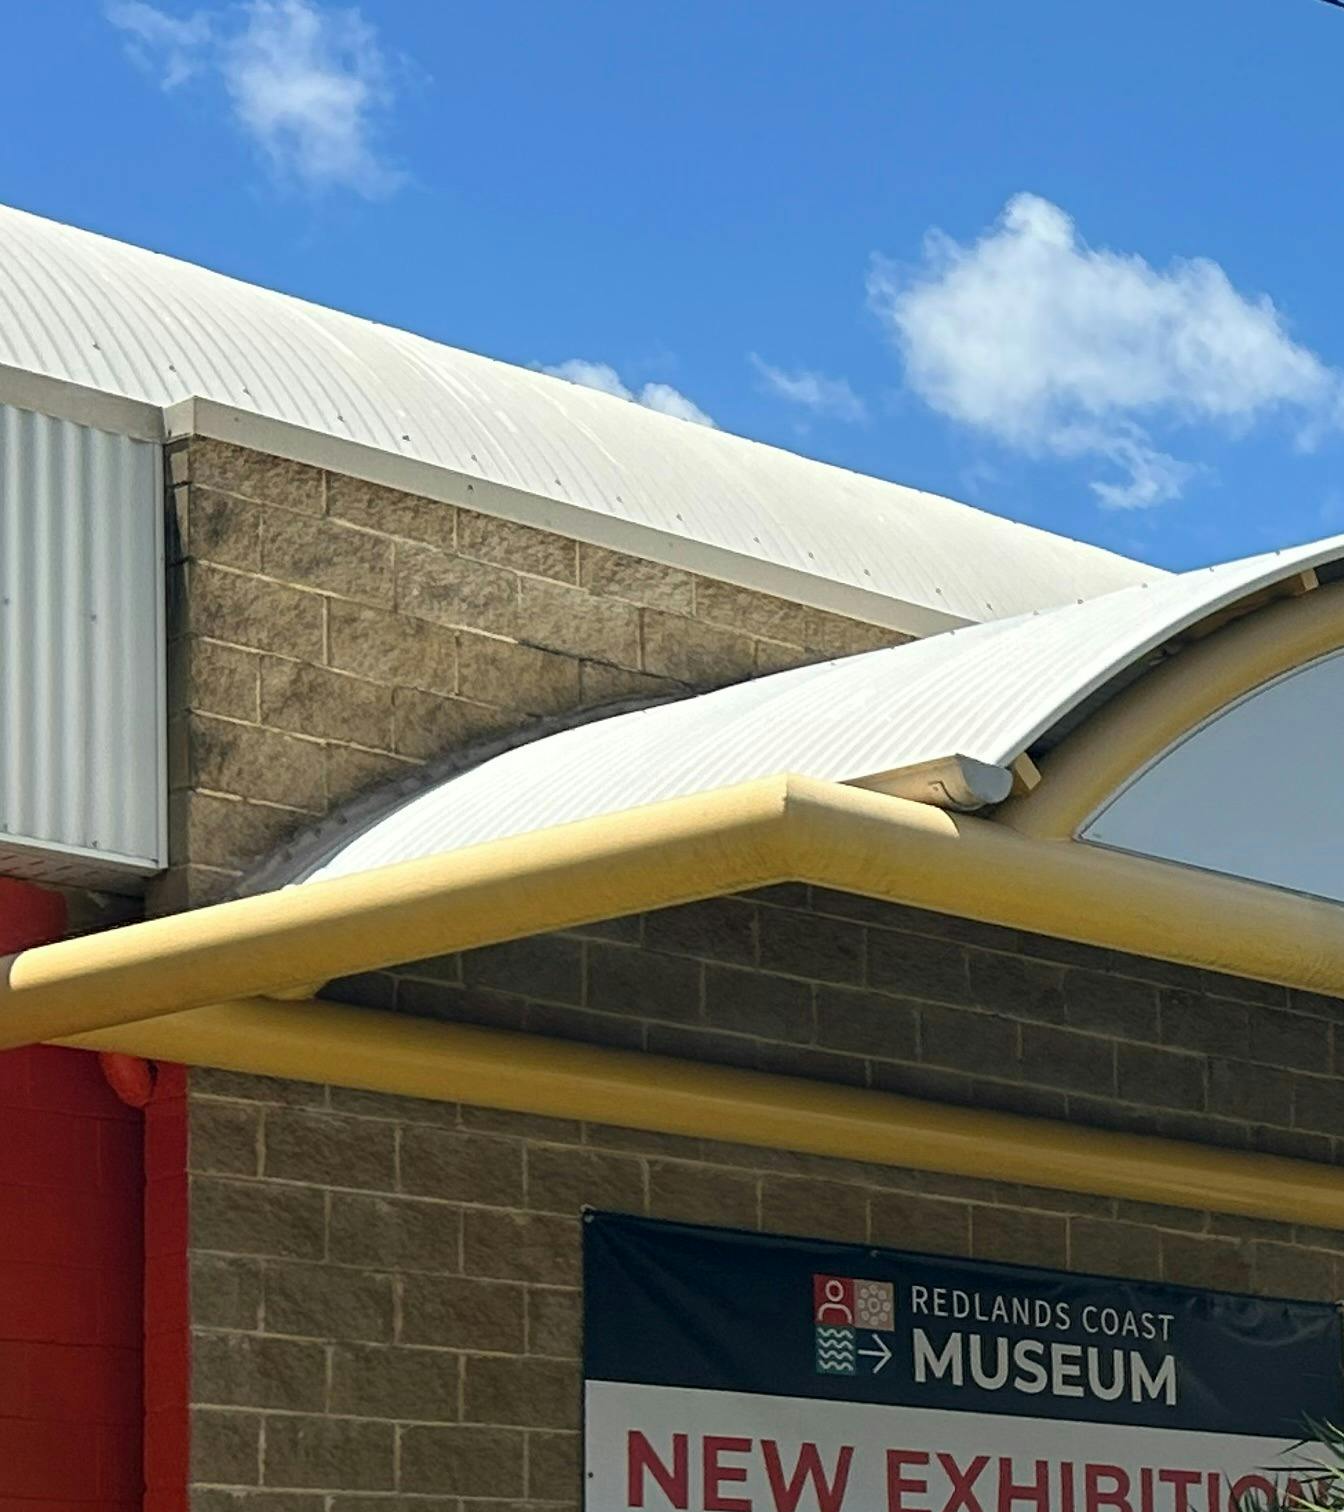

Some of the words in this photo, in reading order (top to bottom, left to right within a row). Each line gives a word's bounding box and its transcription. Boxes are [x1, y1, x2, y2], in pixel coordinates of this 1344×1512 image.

[912, 1285, 1071, 1330] REDLANDS
[1082, 1306, 1175, 1341] COAST
[912, 1328, 1177, 1406] MUSEUM
